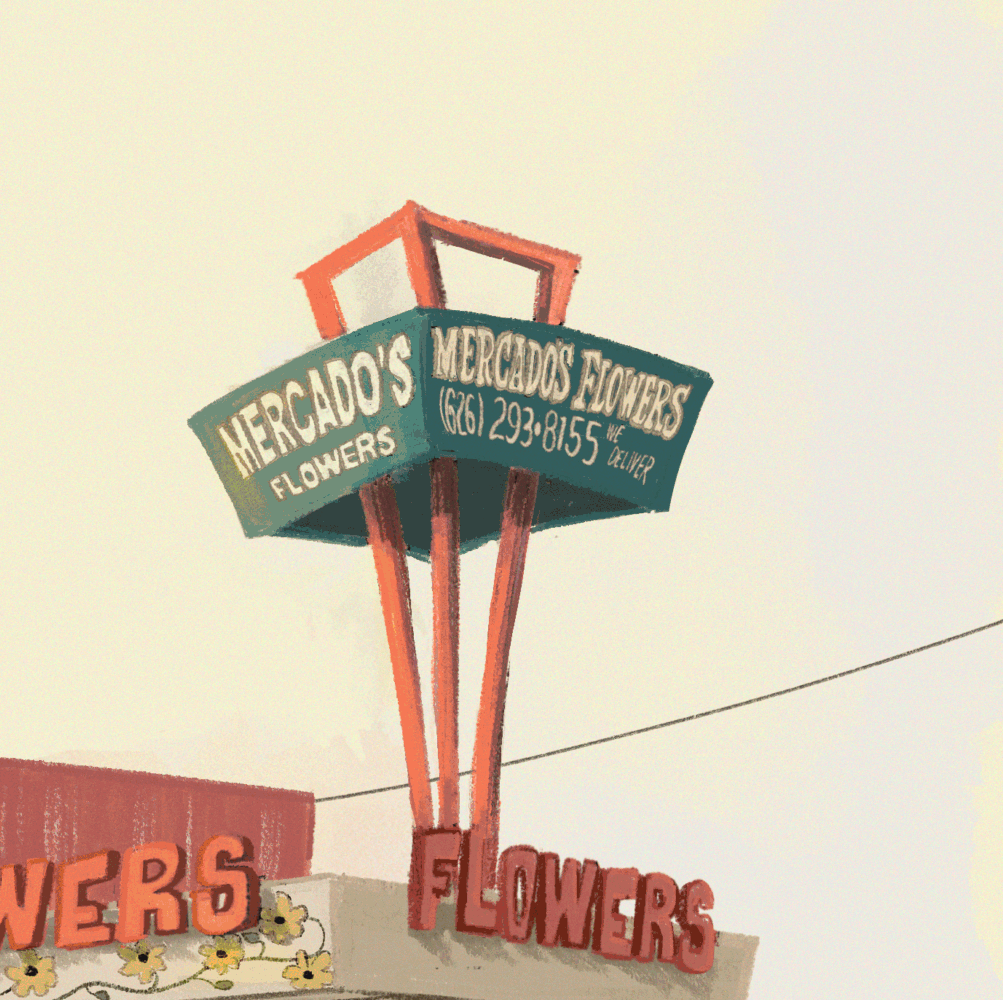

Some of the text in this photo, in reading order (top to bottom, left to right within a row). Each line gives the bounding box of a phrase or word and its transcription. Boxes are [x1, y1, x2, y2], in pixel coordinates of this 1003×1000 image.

[217, 332, 416, 480] MERCADO'S
[439, 384, 484, 437] (626)
[570, 348, 693, 441] FLOWERS
[606, 422, 626, 443] WE
[267, 424, 396, 501] FLOWERS
[607, 446, 655, 486] DELIVER
[407, 826, 715, 974] FLOWERS
